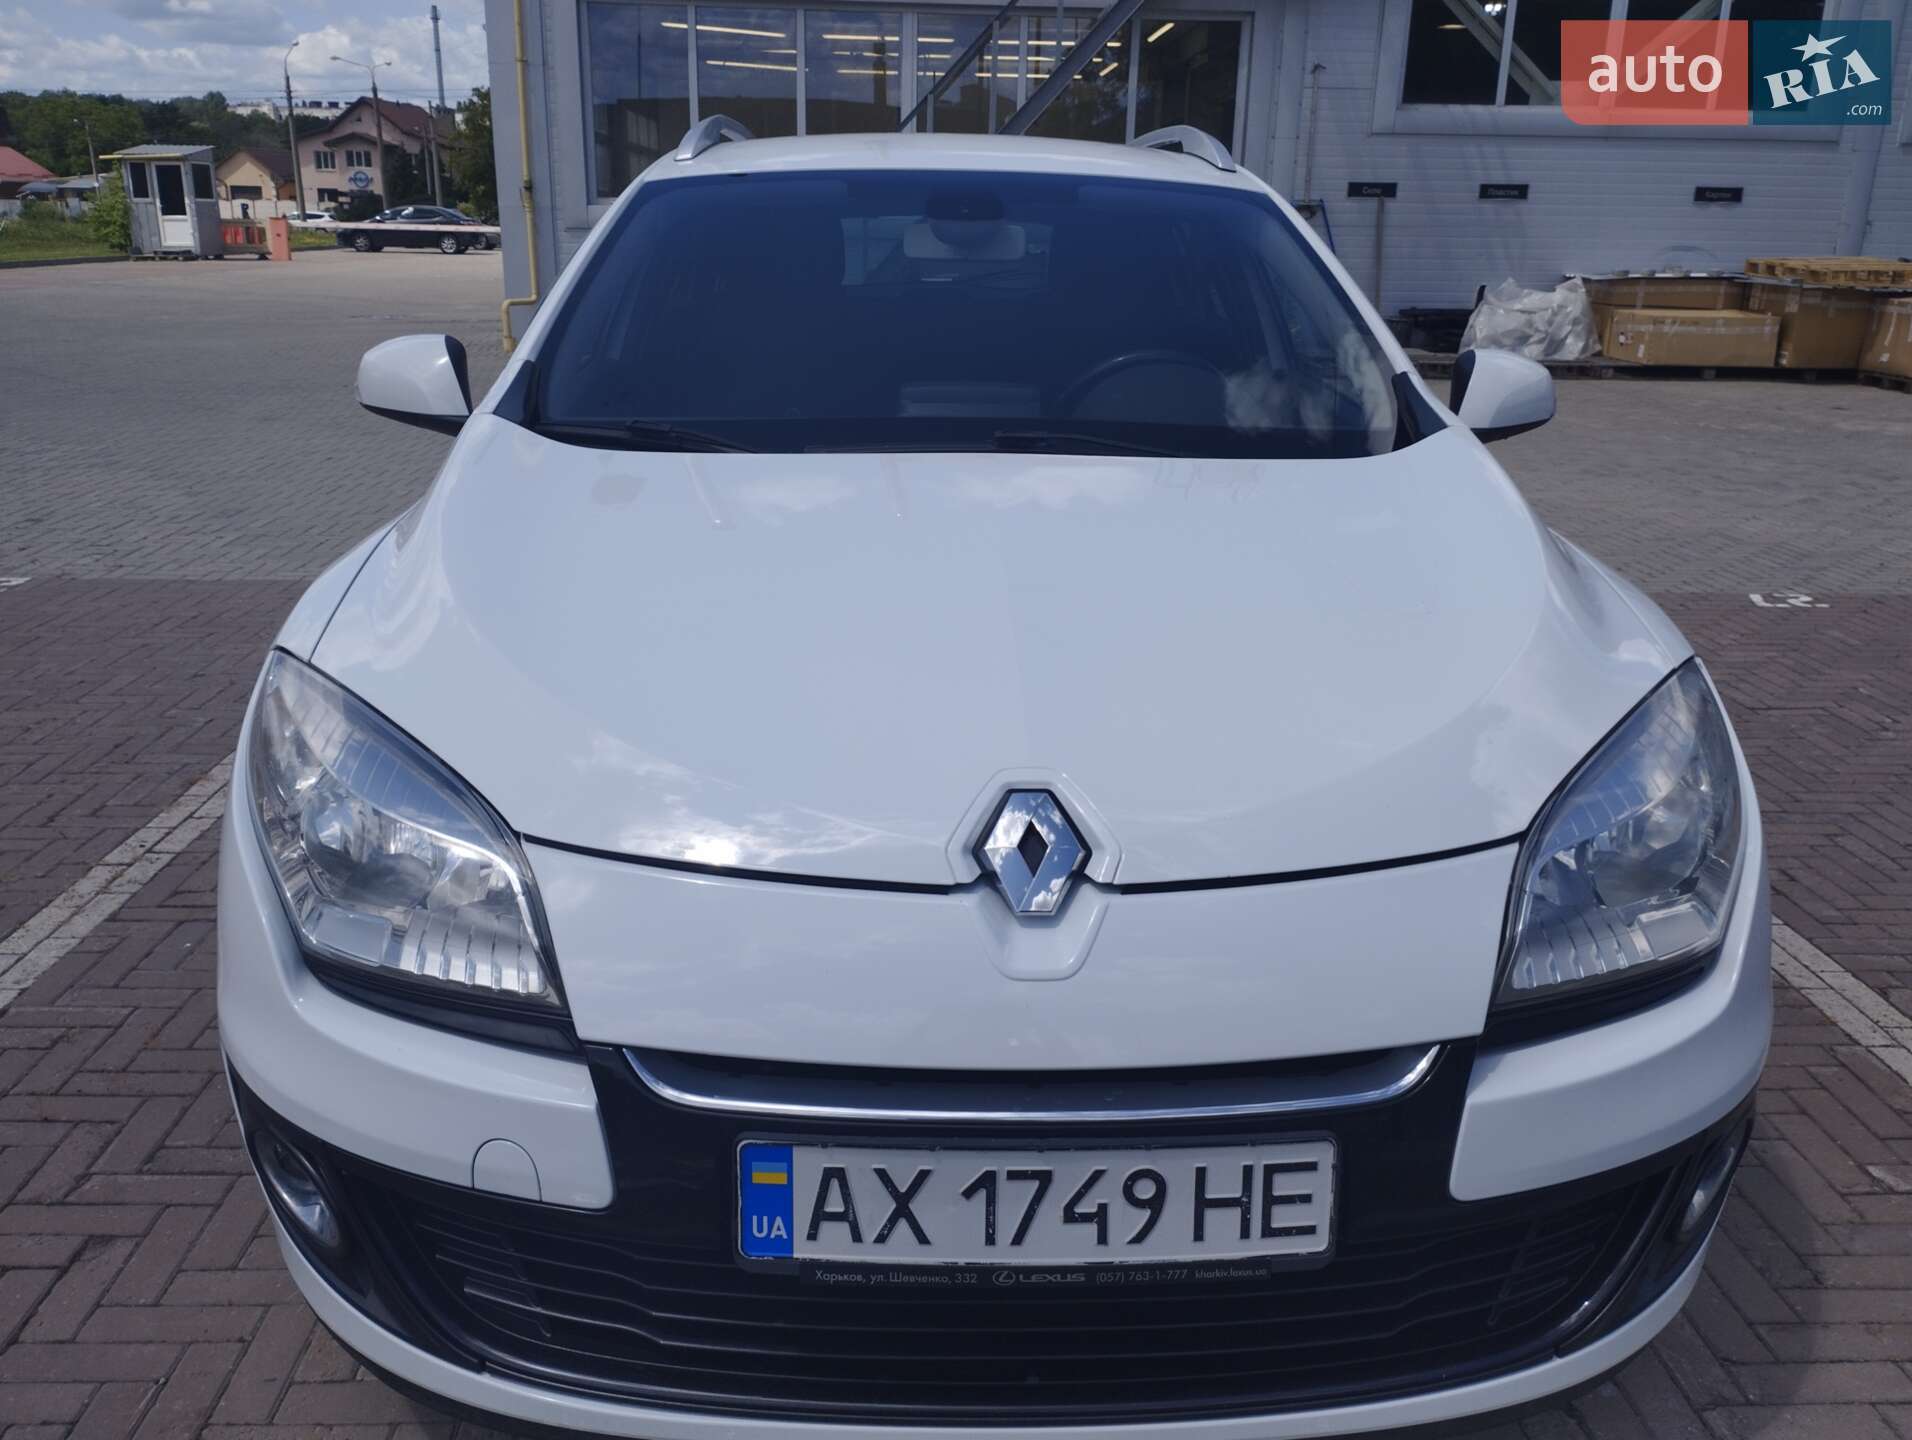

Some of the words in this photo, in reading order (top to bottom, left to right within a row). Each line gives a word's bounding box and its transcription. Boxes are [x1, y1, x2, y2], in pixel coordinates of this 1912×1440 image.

[806, 1166, 932, 1246] AX
[960, 1168, 1167, 1247] 1749
[1193, 1161, 1319, 1242] HE
[752, 1214, 788, 1240] UA
[815, 1270, 867, 1284] Харьков,
[955, 1272, 978, 1284] 332
[1019, 1273, 1086, 1283] LEXUS
[1096, 1270, 1125, 1284] (057)
[1129, 1268, 1188, 1283] 763-1-777
